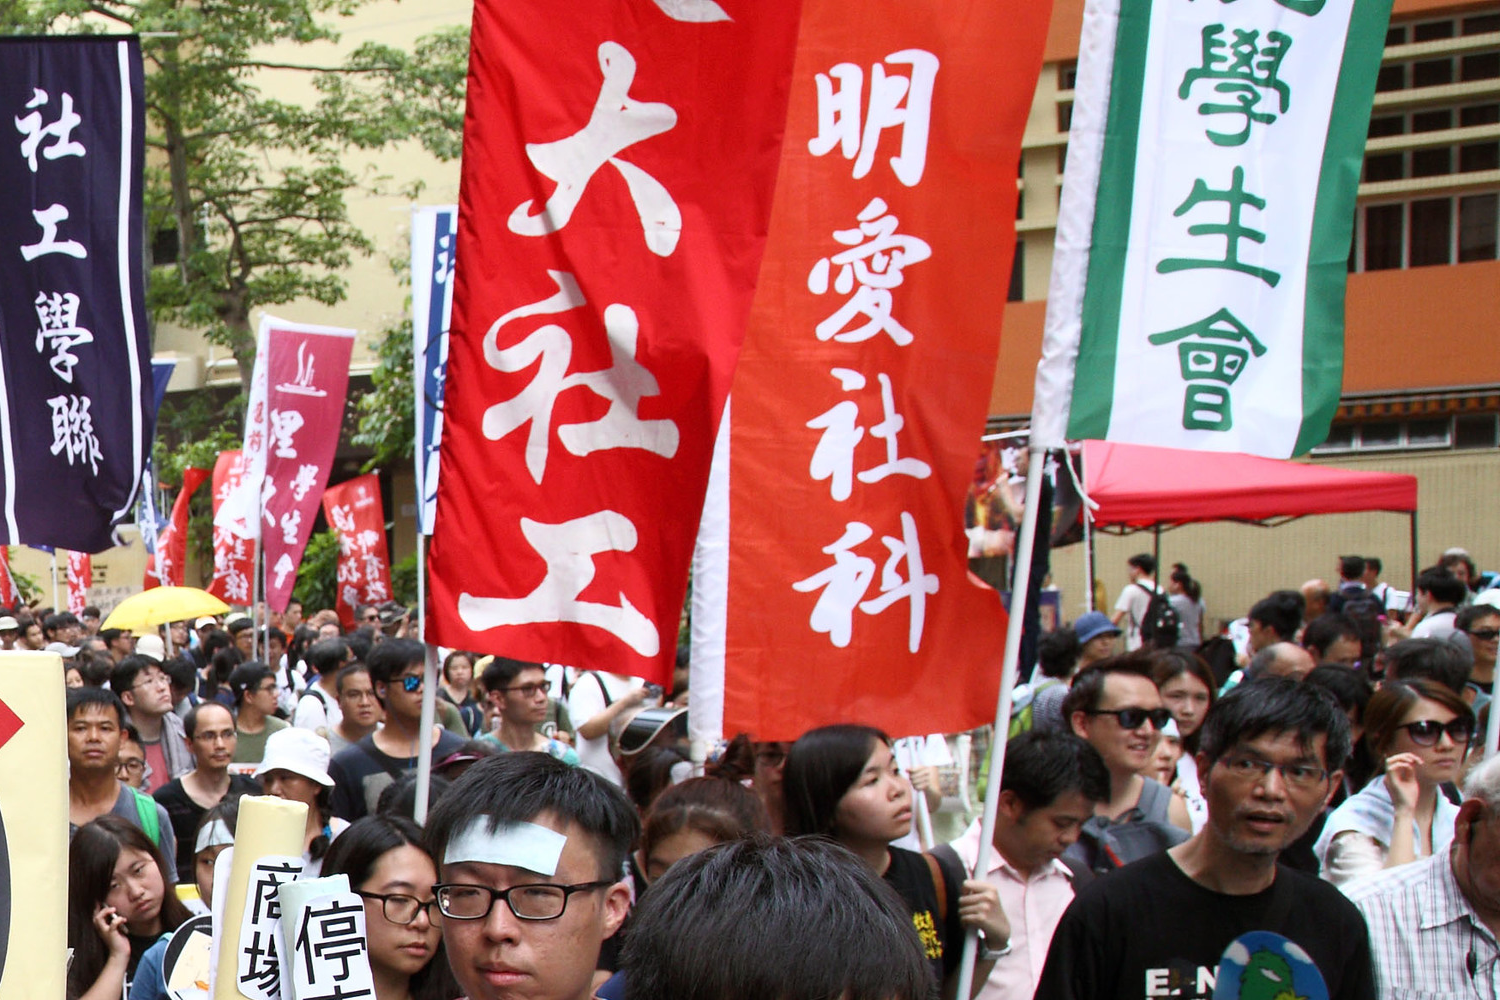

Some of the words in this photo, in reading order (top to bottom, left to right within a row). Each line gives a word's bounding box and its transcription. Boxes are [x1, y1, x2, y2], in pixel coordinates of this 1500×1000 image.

[15, 88, 104, 478] 社工學聯
[458, 0, 735, 657] 大社工
[793, 48, 941, 654] 明愛社科
[1147, 0, 1328, 433] 學生會
